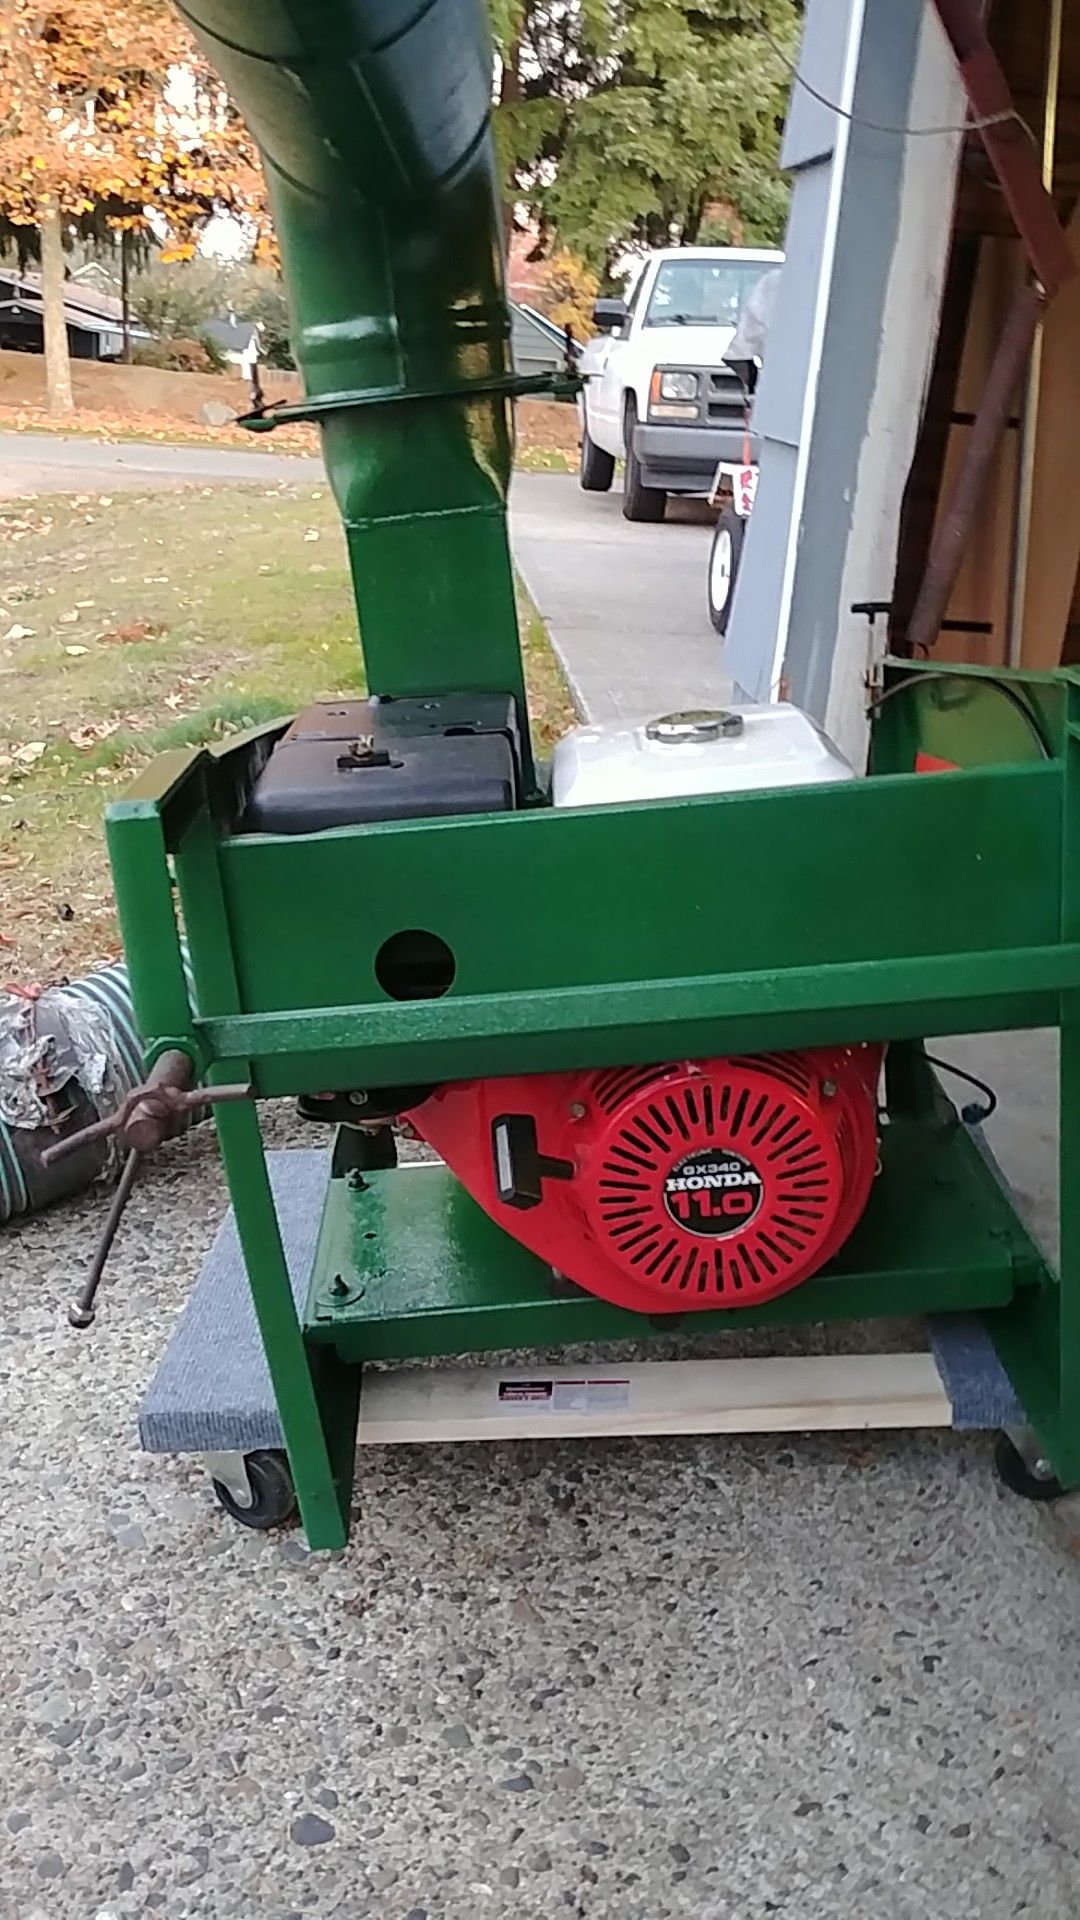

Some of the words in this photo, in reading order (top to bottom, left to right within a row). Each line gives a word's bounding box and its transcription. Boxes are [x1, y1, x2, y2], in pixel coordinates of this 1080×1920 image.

[683, 1162, 741, 1175] GX340
[666, 1172, 762, 1191] HONDA
[670, 1190, 753, 1219] 11.0
